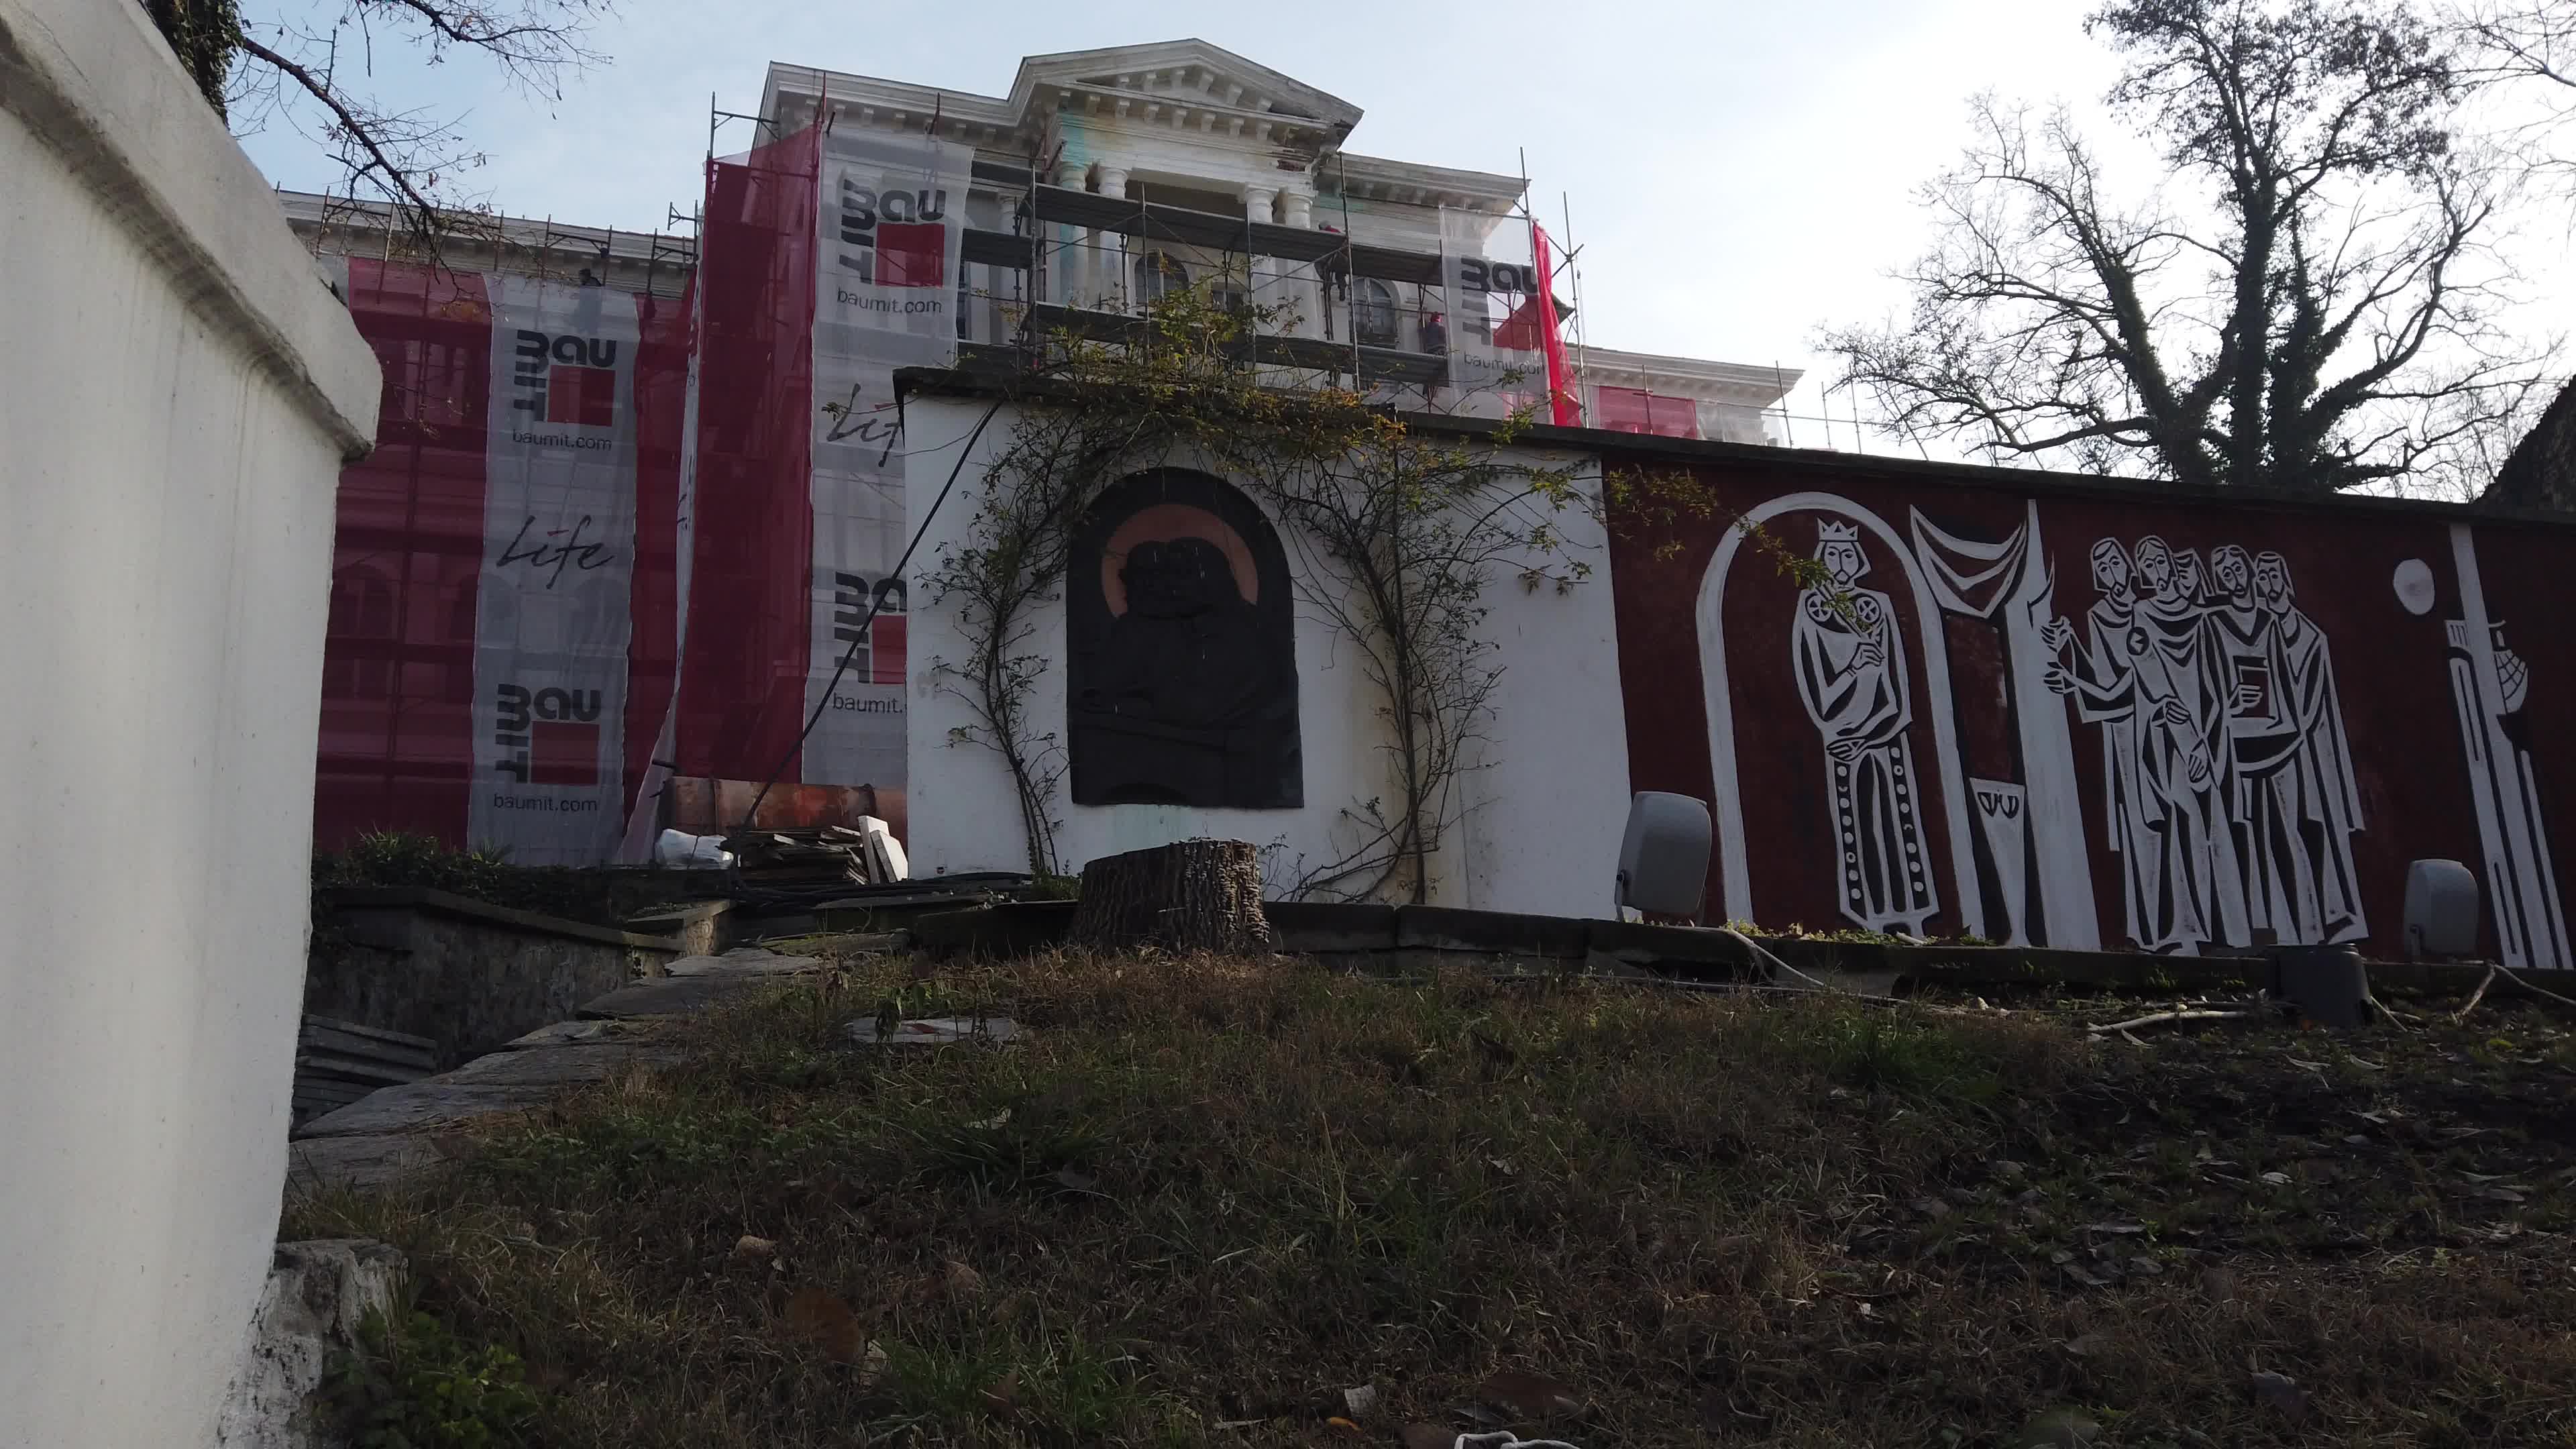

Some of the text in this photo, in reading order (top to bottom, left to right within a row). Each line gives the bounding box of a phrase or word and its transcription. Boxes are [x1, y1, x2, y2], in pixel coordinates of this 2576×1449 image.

[837, 286, 943, 314] baumit.com
[513, 429, 612, 451] baumit.com
[496, 515, 615, 589] Life
[493, 794, 598, 812] baumit.com
